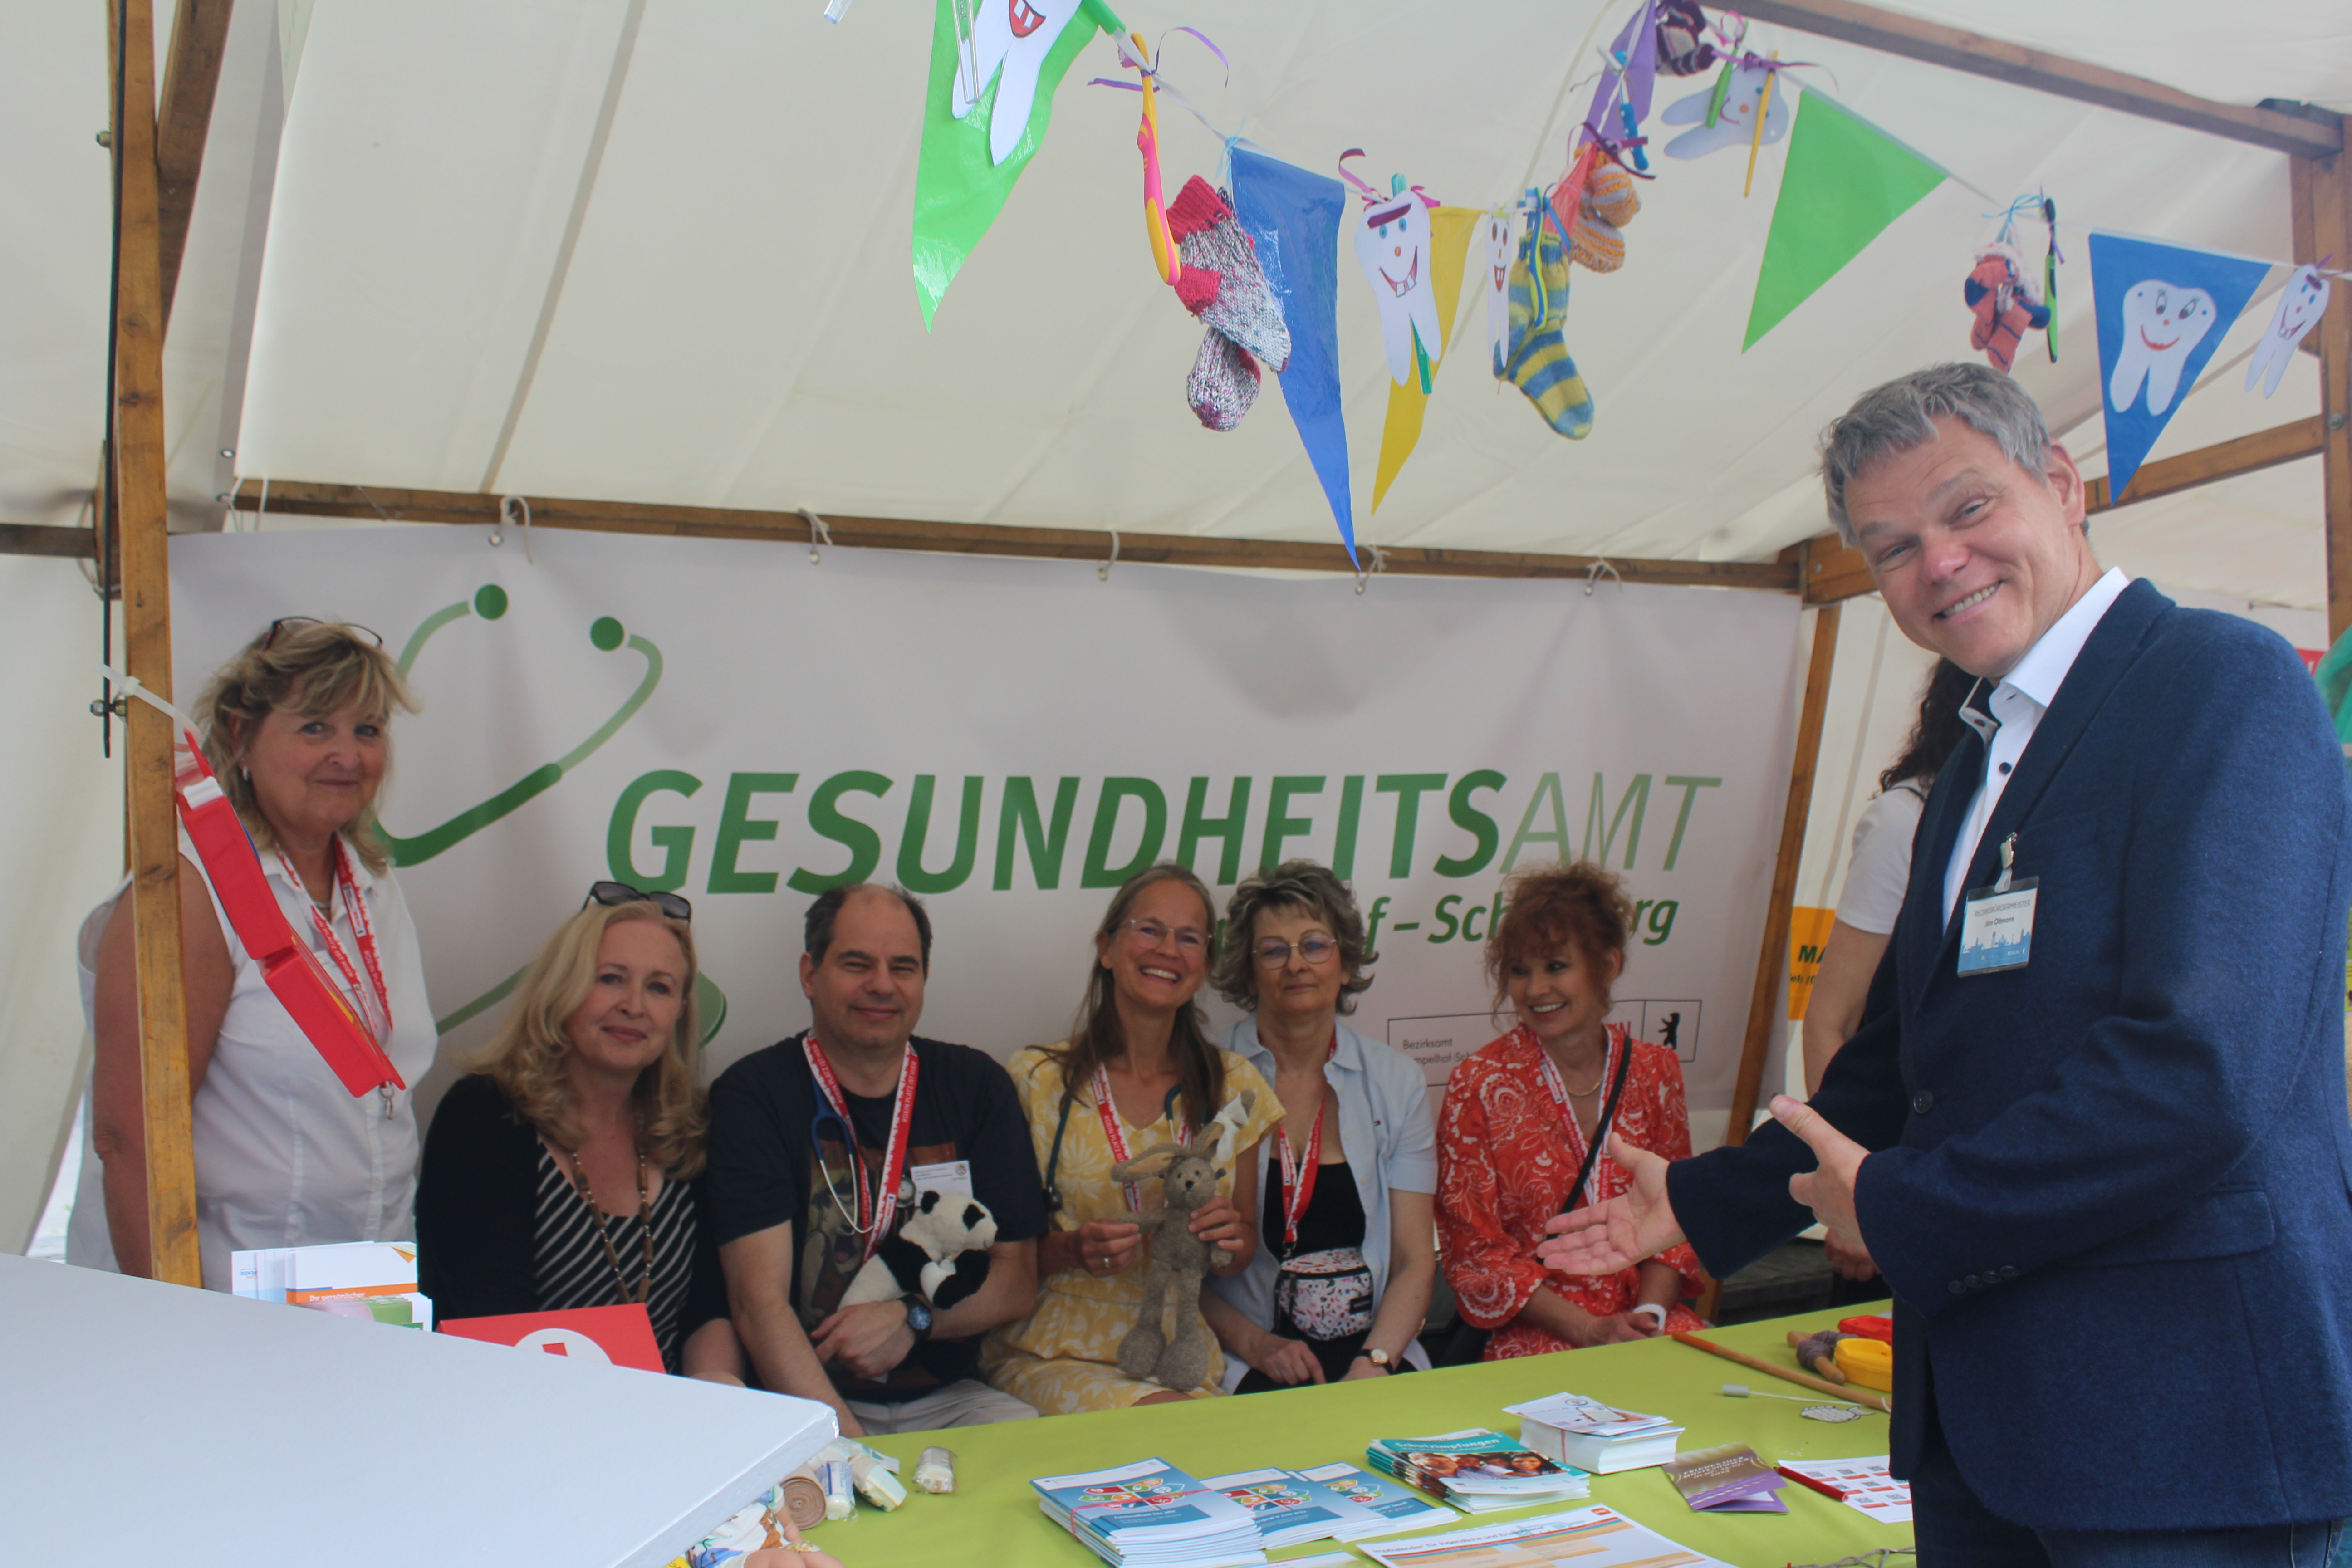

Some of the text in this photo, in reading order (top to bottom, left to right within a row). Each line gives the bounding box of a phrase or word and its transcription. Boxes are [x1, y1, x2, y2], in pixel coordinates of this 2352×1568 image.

[606, 768, 1724, 896] GESUNDHEITSAMT
[1402, 1037, 1453, 1050] Bezirksamt
[904, 1084, 914, 1103] PLATZ
[1109, 1134, 1122, 1153] PLATZ
[321, 1292, 365, 1301] persönlicher
[1395, 1437, 1500, 1450] Schutzimpfungen
